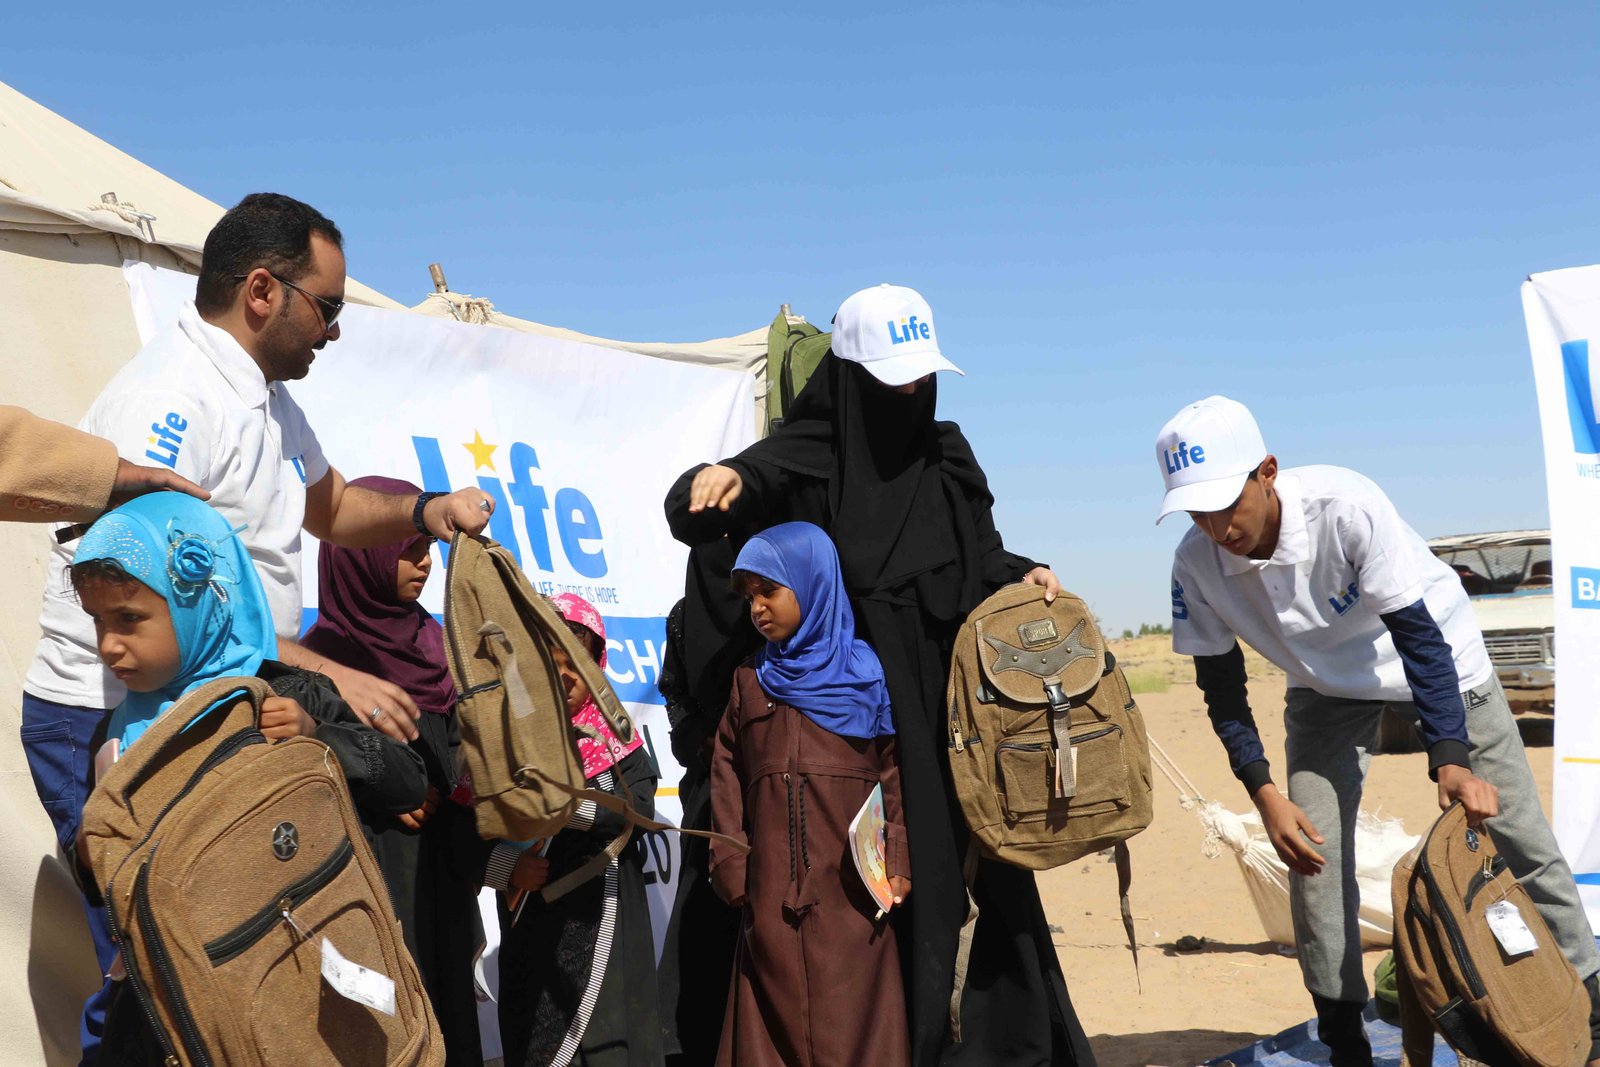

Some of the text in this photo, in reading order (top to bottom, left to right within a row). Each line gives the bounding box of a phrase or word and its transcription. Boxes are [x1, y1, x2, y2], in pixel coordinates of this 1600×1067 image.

[887, 315, 930, 345] Life
[145, 412, 187, 469] Life
[1164, 441, 1206, 475] Life
[594, 586, 620, 604] HOPE
